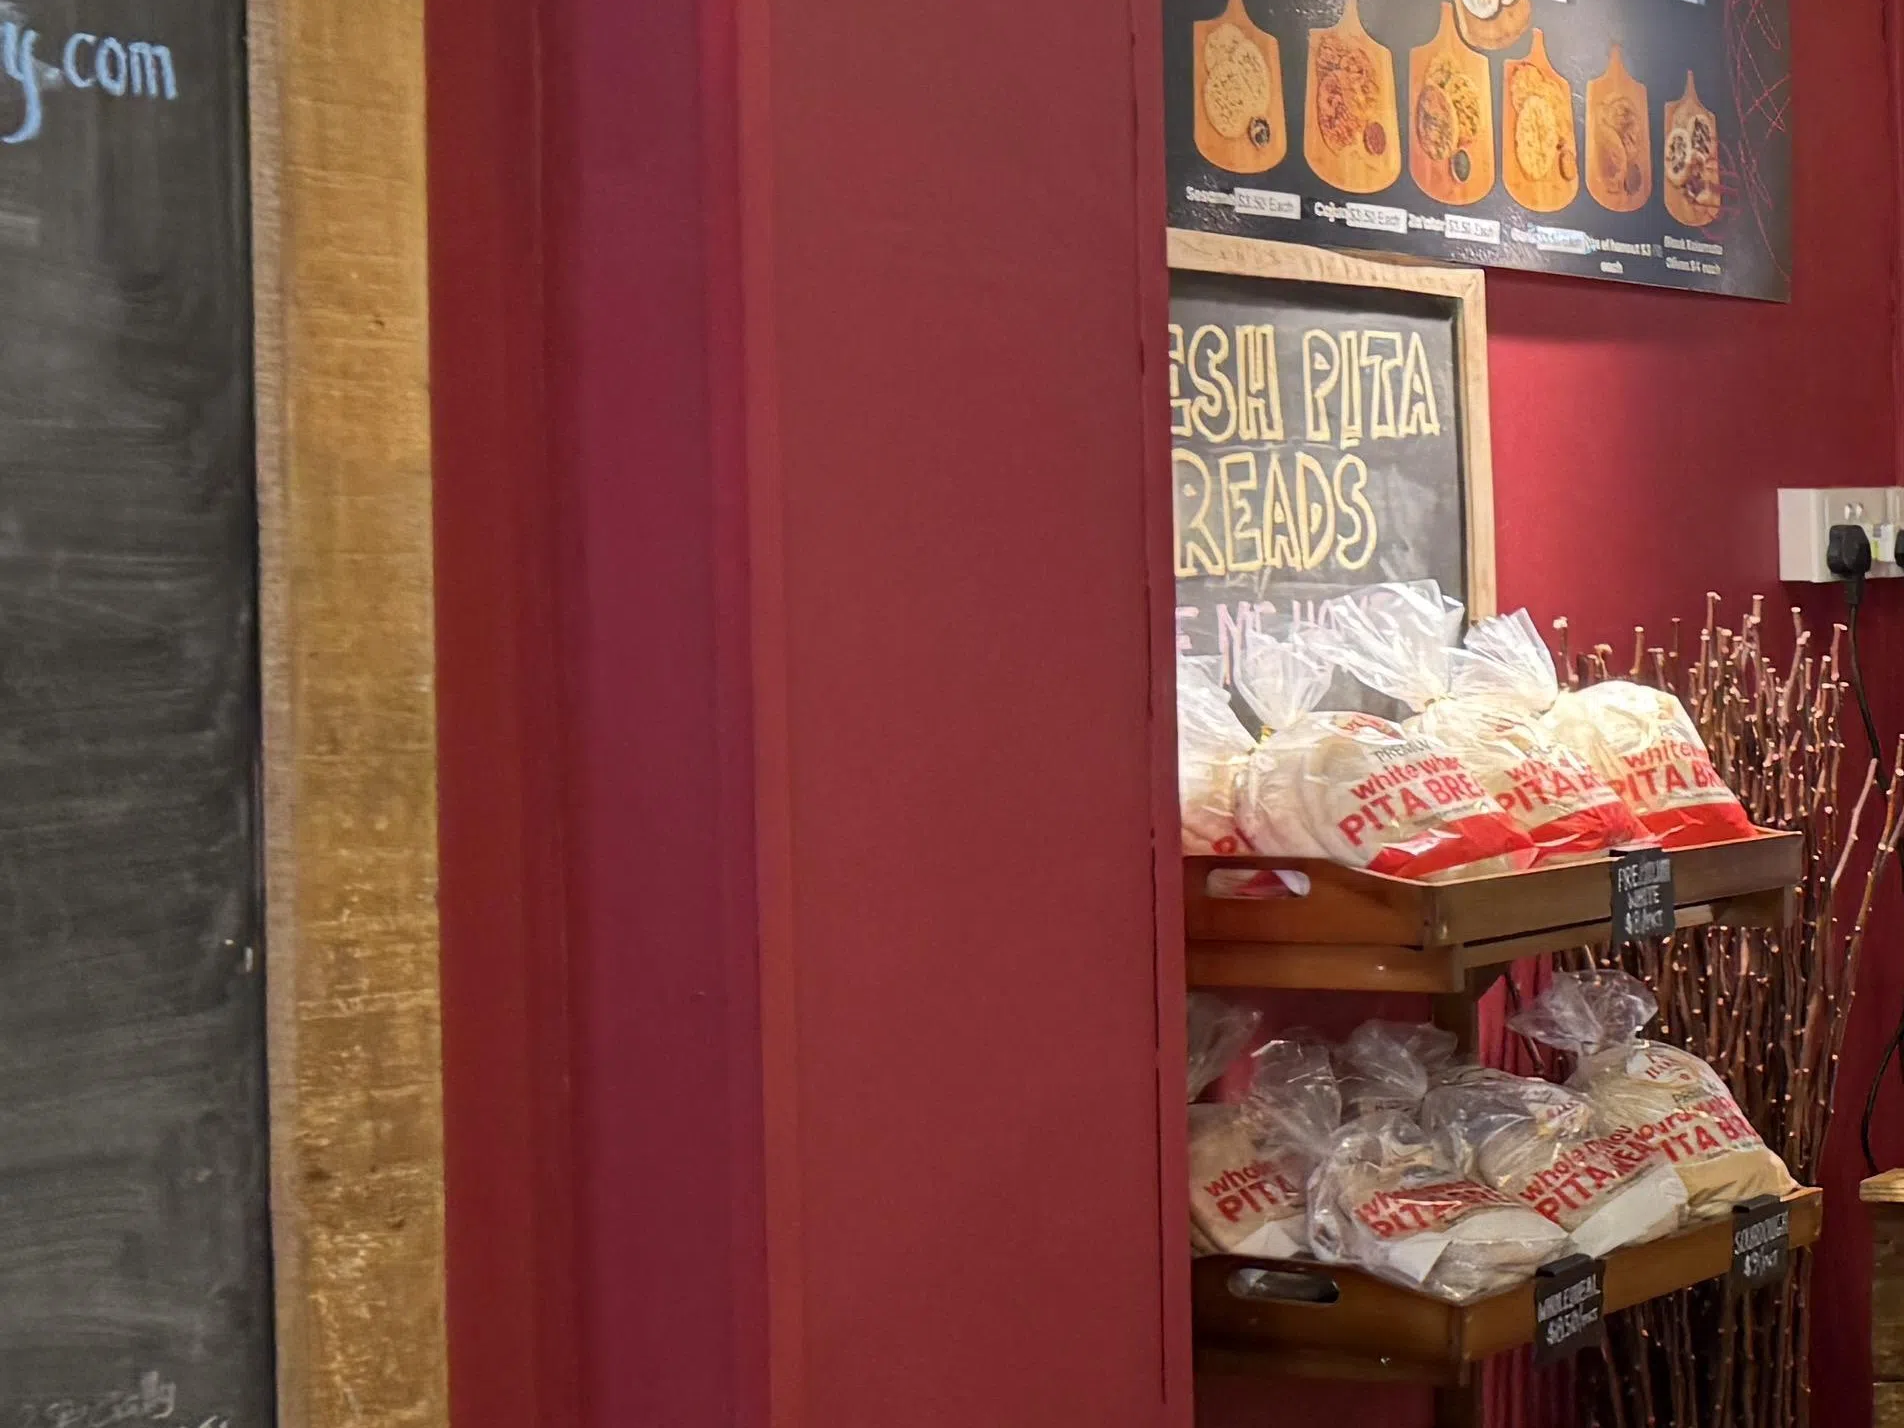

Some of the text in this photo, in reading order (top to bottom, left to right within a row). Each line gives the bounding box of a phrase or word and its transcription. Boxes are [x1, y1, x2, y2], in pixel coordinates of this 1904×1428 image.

[1303, 329, 1440, 449] PITA
[1172, 447, 1377, 577] READS
[1349, 763, 1424, 801] white
[1337, 791, 1425, 847] PITA
[1534, 1163, 1618, 1227] PITA
